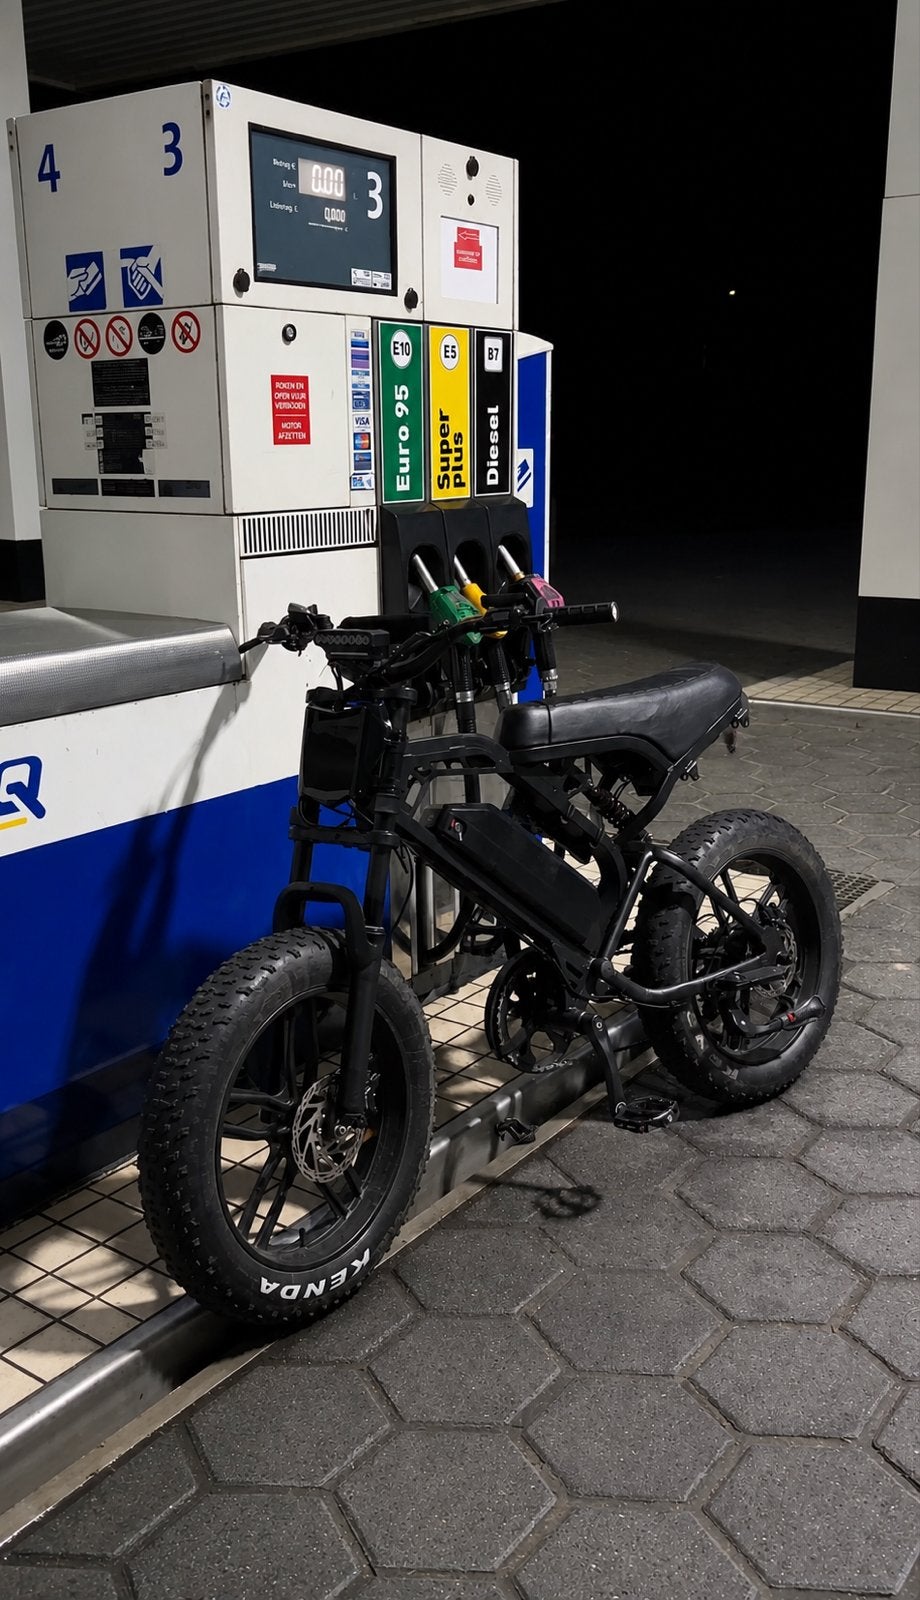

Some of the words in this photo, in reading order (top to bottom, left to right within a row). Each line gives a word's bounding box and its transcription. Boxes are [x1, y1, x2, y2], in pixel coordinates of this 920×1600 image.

[37, 144, 61, 192] 4
[162, 122, 184, 176] 3
[367, 171, 384, 220] 3
[393, 341, 411, 357] E10
[443, 345, 457, 359] E5
[487, 347, 500, 361] B7
[355, 417, 370, 426] VISA
[395, 384, 409, 418] 95
[396, 425, 411, 492] Euro
[437, 408, 453, 490] Super
[451, 431, 466, 488] plus
[486, 405, 499, 485] Diesel
[259, 1247, 371, 1300] KENDA
